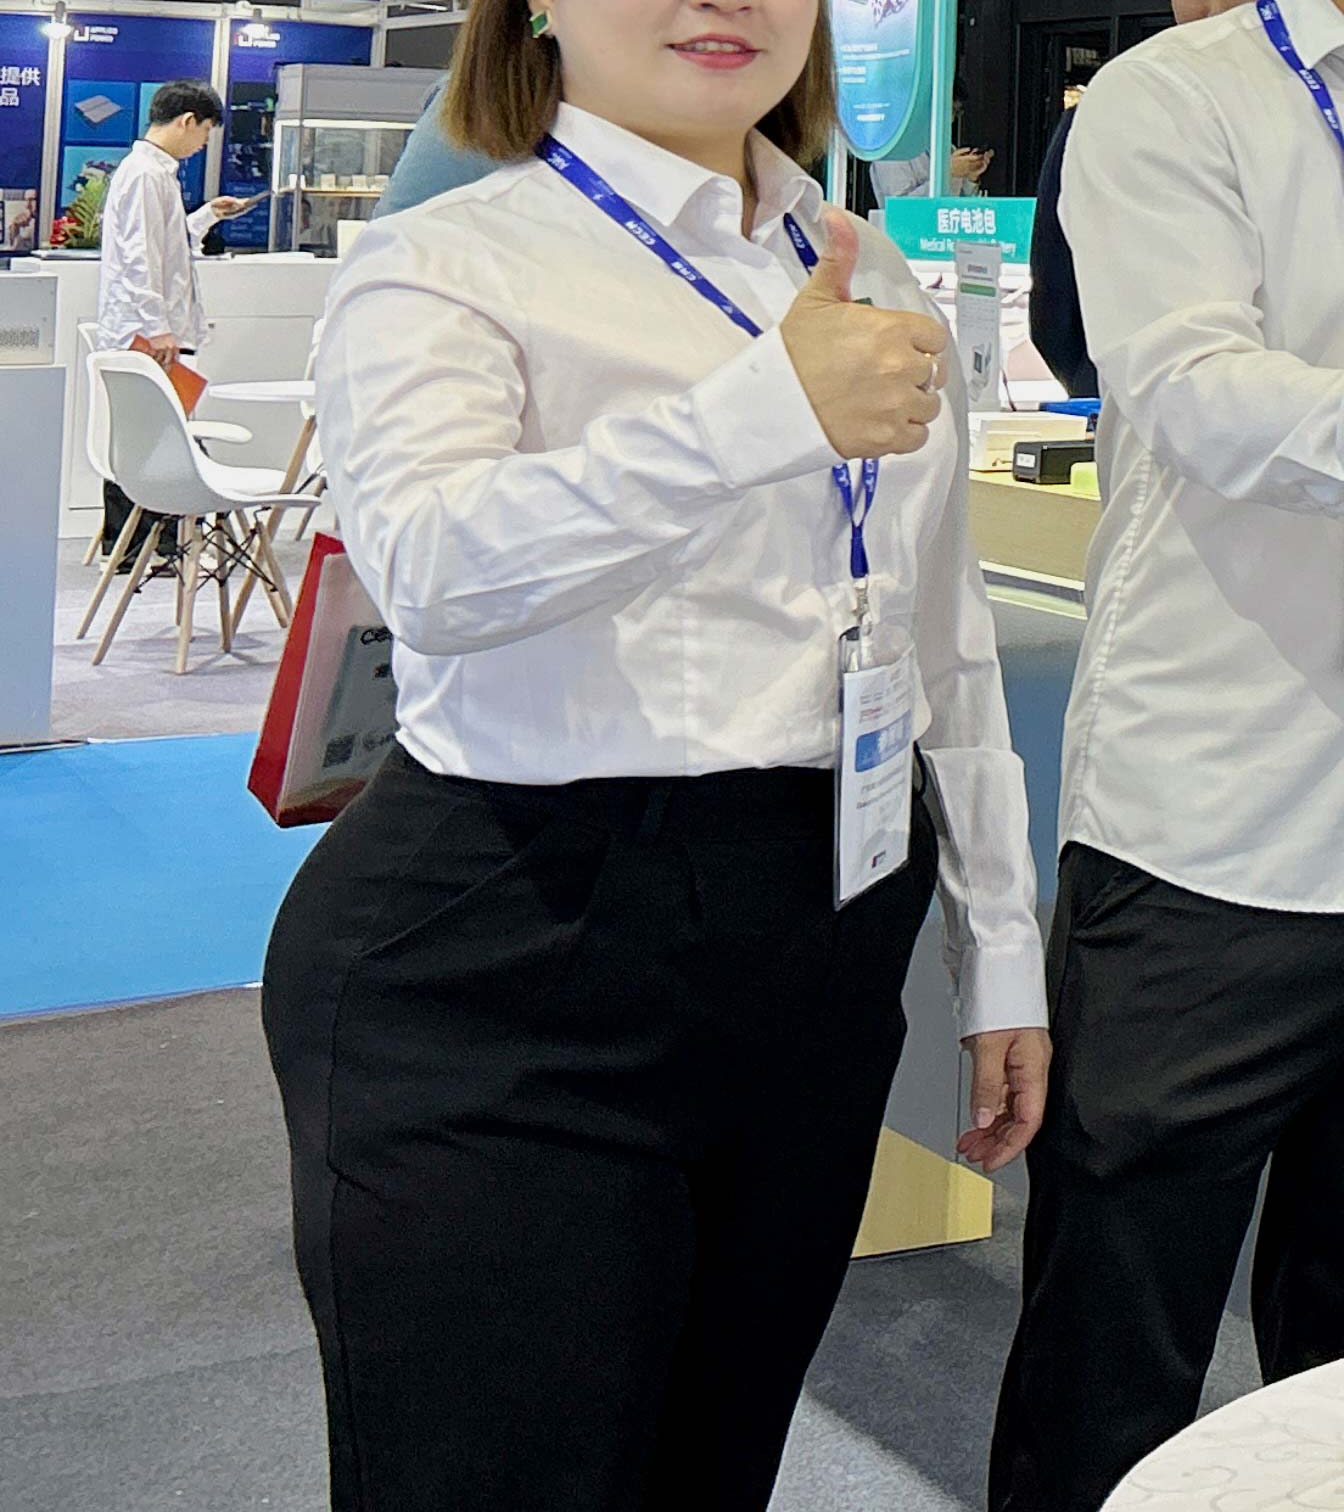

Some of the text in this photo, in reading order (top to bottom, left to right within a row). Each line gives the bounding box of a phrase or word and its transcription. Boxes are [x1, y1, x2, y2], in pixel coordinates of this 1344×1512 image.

[937, 208, 997, 235] 医疗电池包
